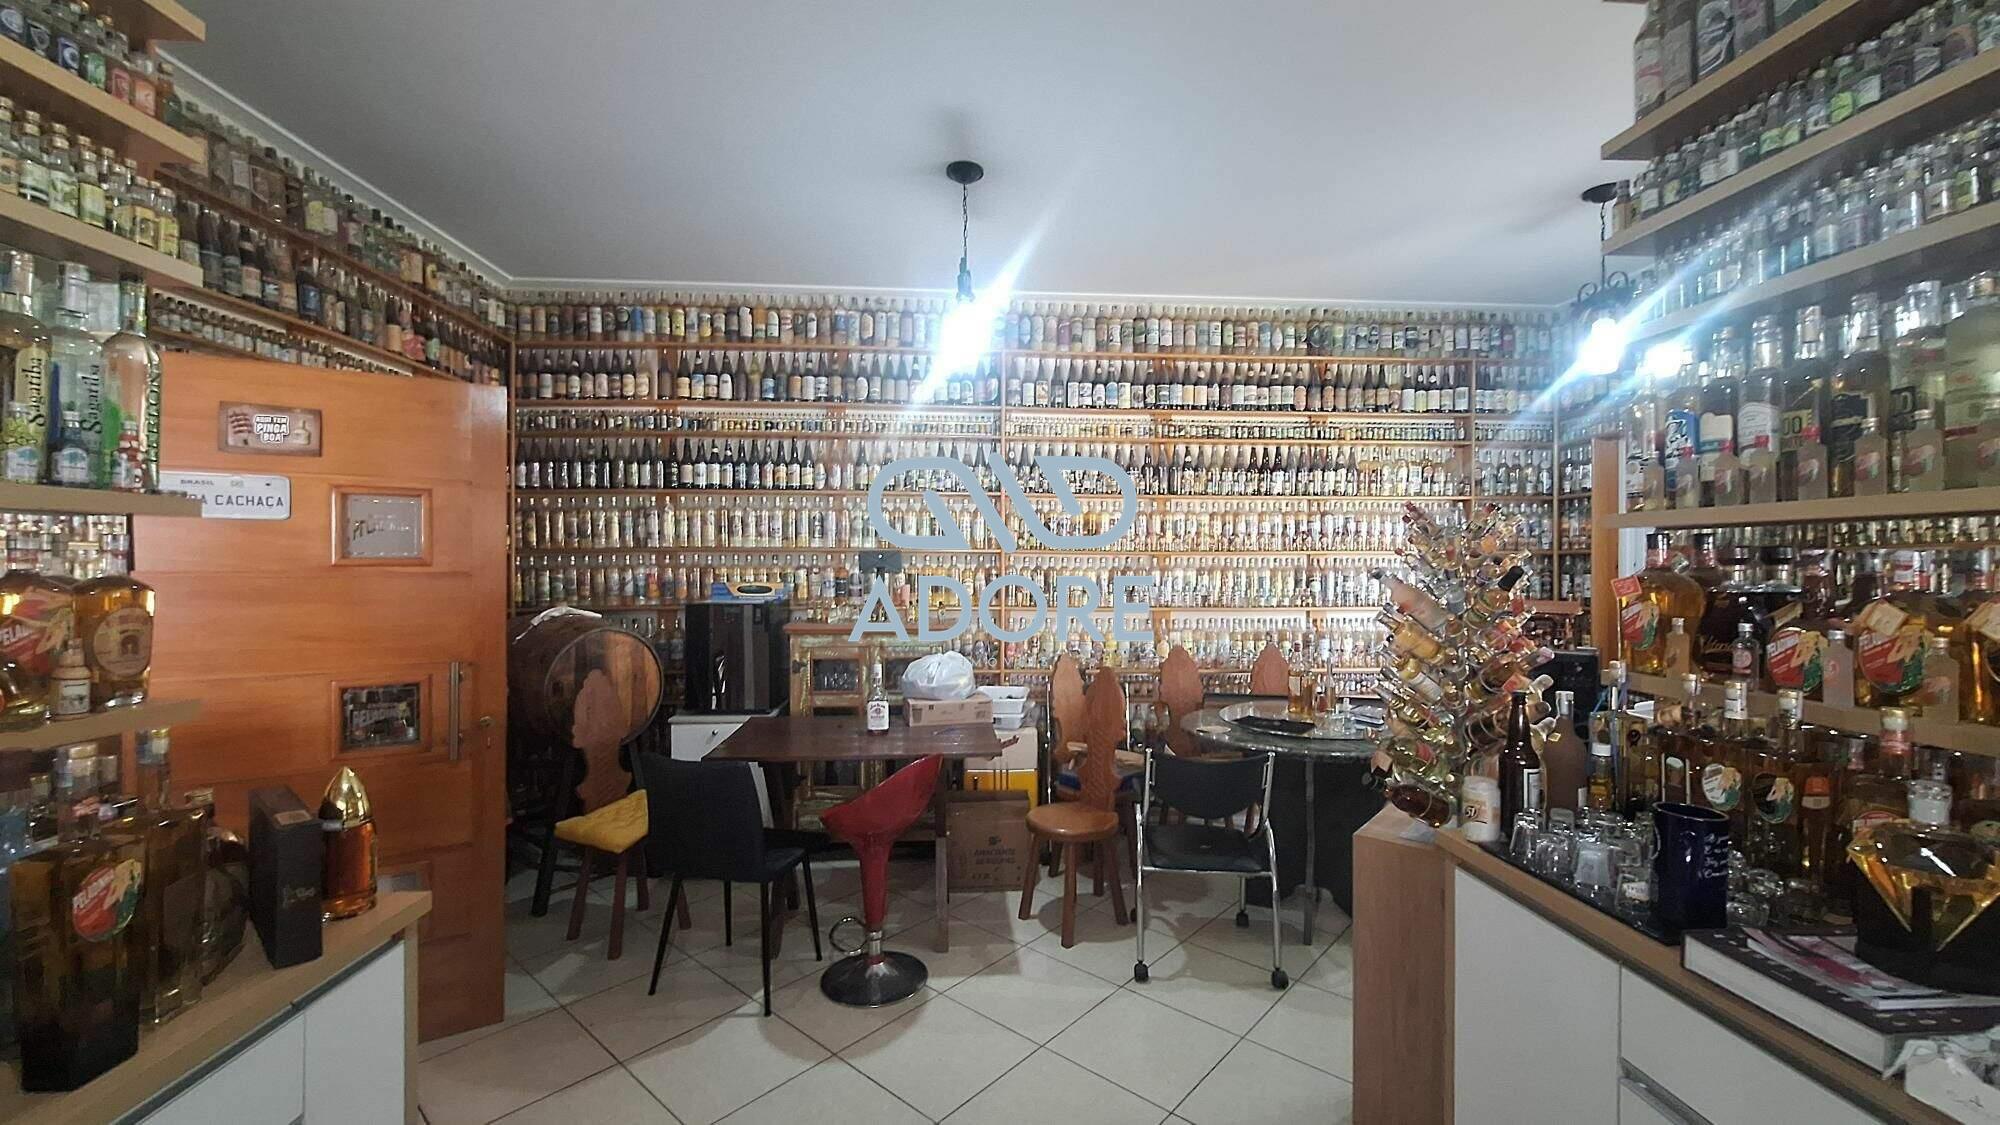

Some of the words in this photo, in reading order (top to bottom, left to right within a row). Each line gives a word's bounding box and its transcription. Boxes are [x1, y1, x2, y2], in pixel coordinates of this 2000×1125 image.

[22, 358, 45, 427] Sagatiba
[80, 364, 102, 434] Sagatiba
[256, 423, 287, 434] PINGA
[263, 433, 281, 442] BOA
[1465, 805, 1477, 818] 51
